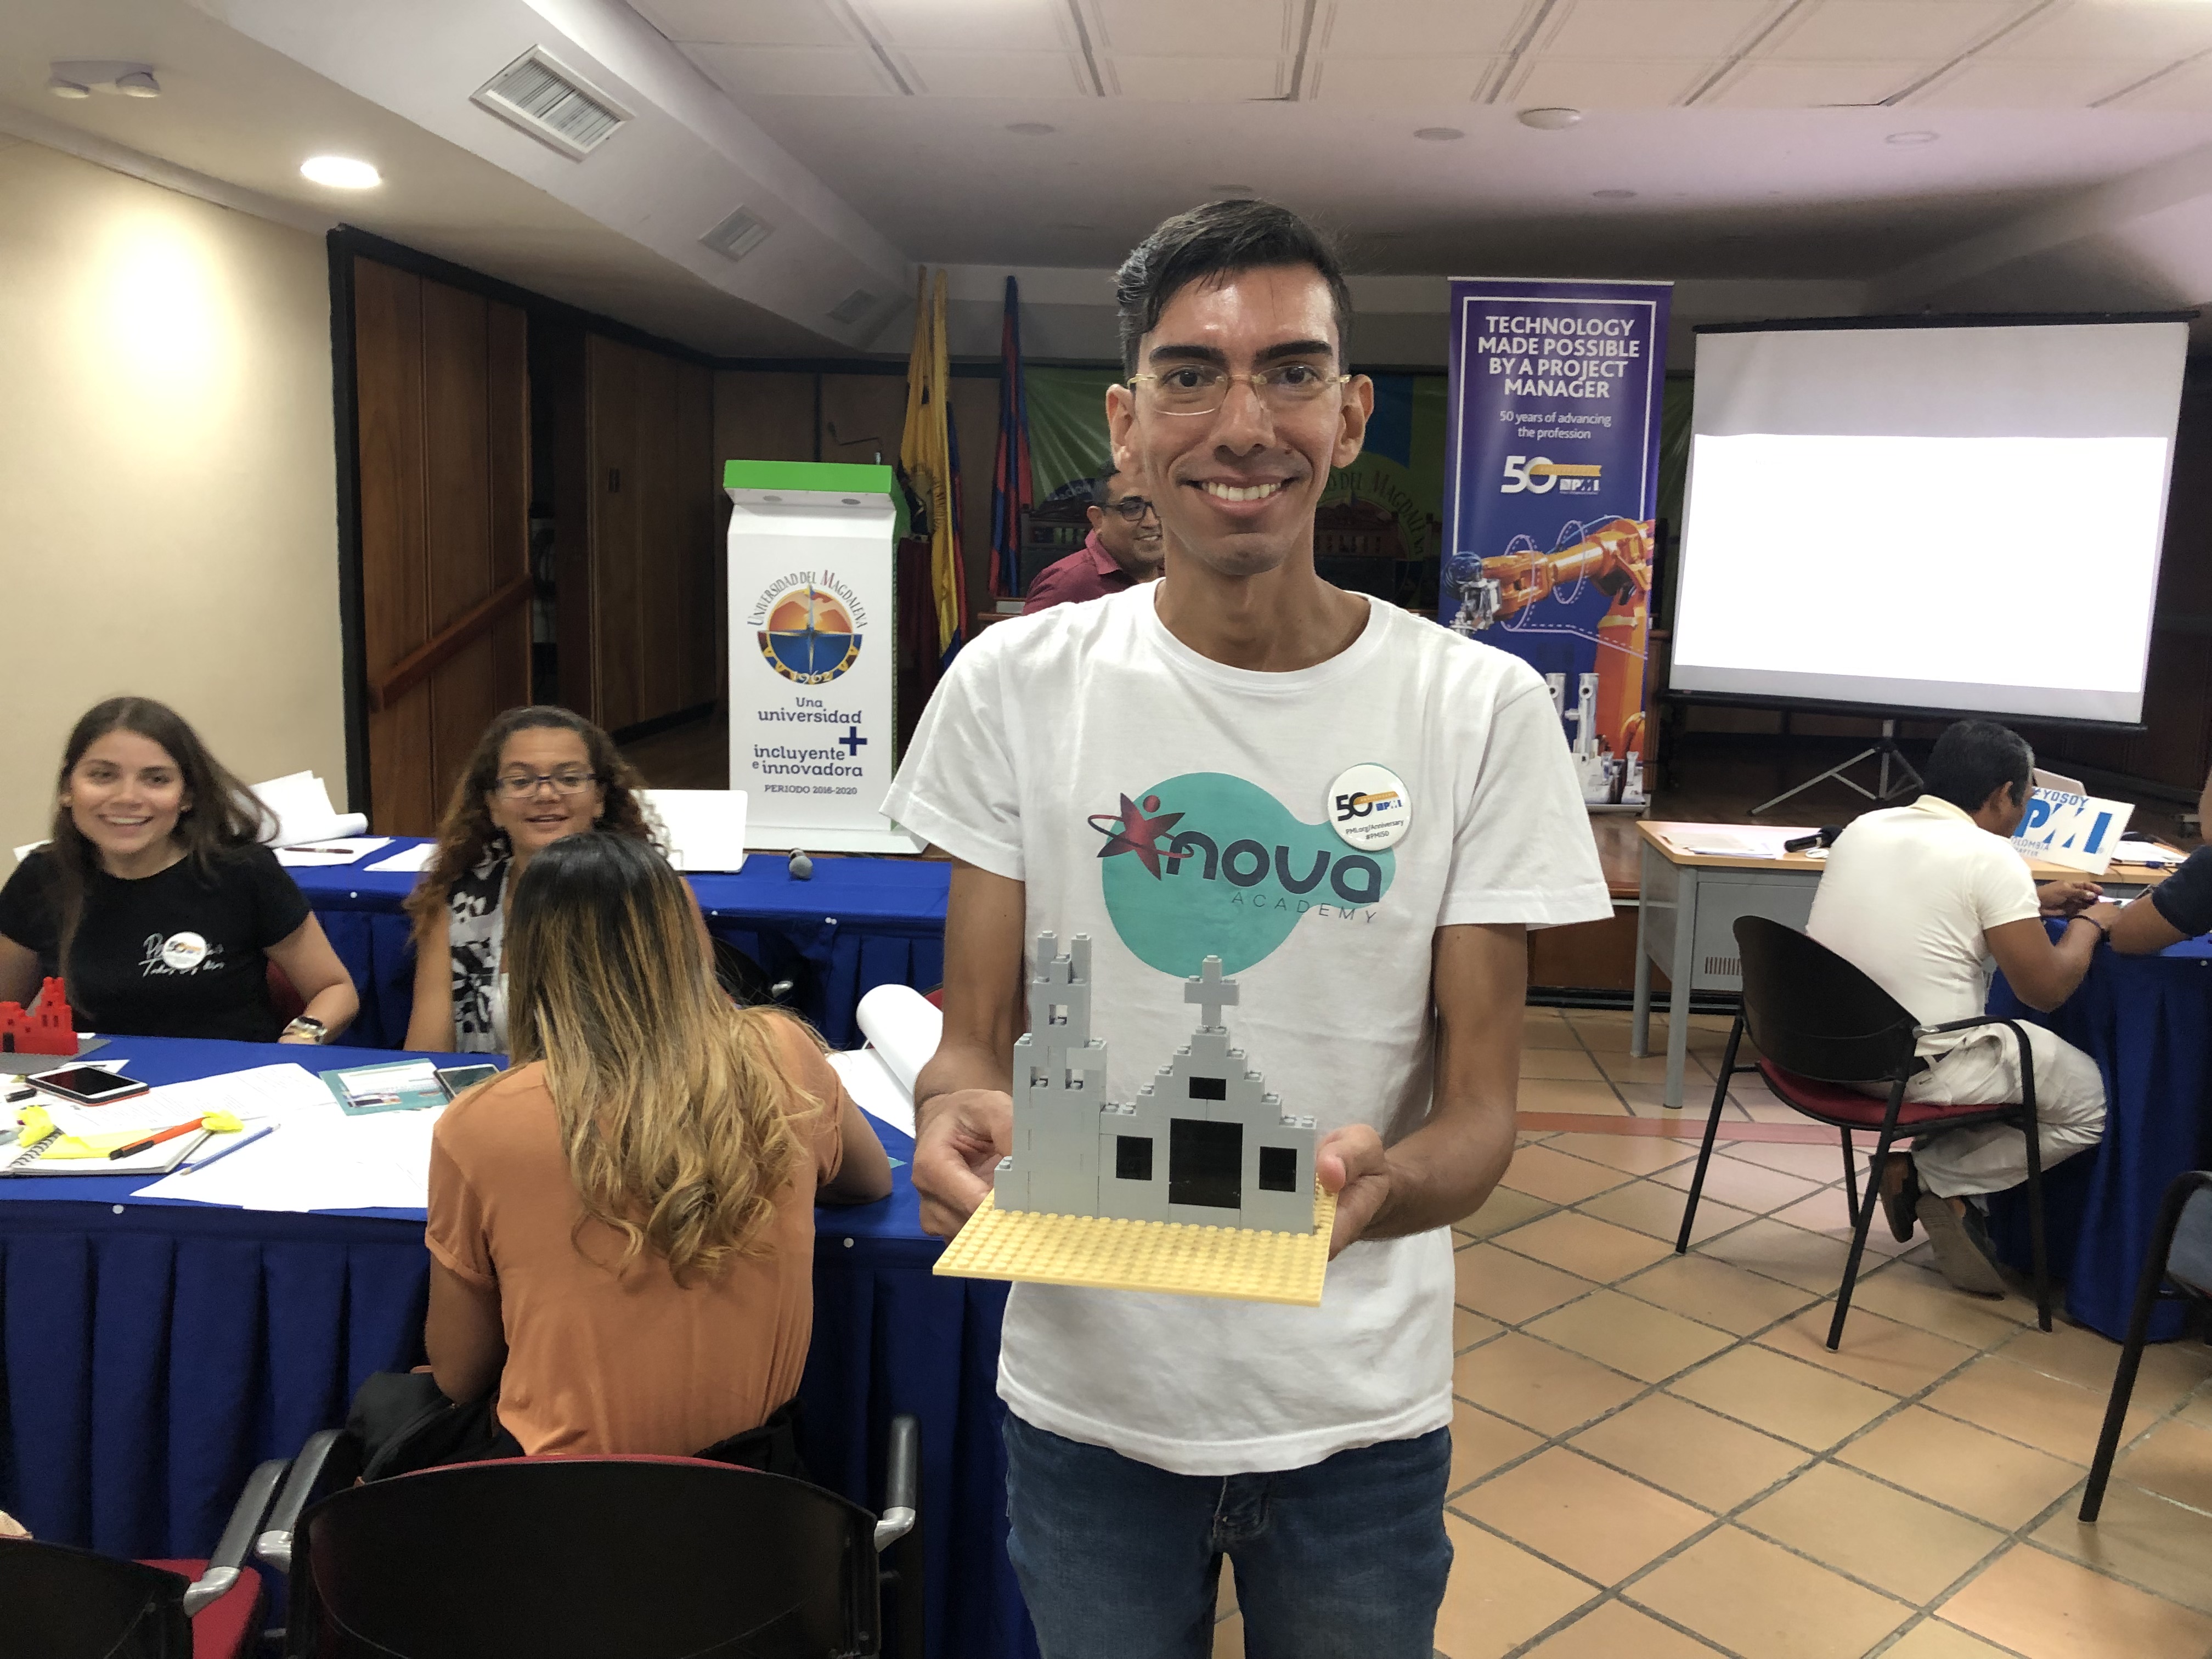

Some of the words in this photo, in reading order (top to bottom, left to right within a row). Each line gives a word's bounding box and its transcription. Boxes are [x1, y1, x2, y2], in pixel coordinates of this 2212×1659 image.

[1485, 315, 1635, 336] TECHNOLOGY
[1477, 336, 1539, 355] MADE
[1543, 338, 1640, 357] POSSIBLE
[1488, 357, 1516, 375] BY
[1518, 358, 1533, 375] A
[1537, 359, 1629, 381] PROJECT
[1504, 378, 1610, 398] MANAGER
[1500, 410, 1514, 421] 50
[1515, 414, 1543, 425] years
[1544, 411, 1557, 423] of
[1558, 413, 1612, 427] advancing
[1518, 426, 1535, 437] the
[1537, 427, 1591, 441] profession
[1500, 455, 1558, 494] 50
[794, 670, 831, 684] 1962
[795, 697, 823, 707] Una
[758, 707, 862, 724] universidad
[754, 744, 845, 763] incluyente
[762, 760, 863, 777] innovadora
[764, 785, 810, 793] PERIODO
[1336, 792, 1373, 821] 50
[2013, 798, 2112, 854] PMI
[1232, 891, 1378, 923] ACADEMY
